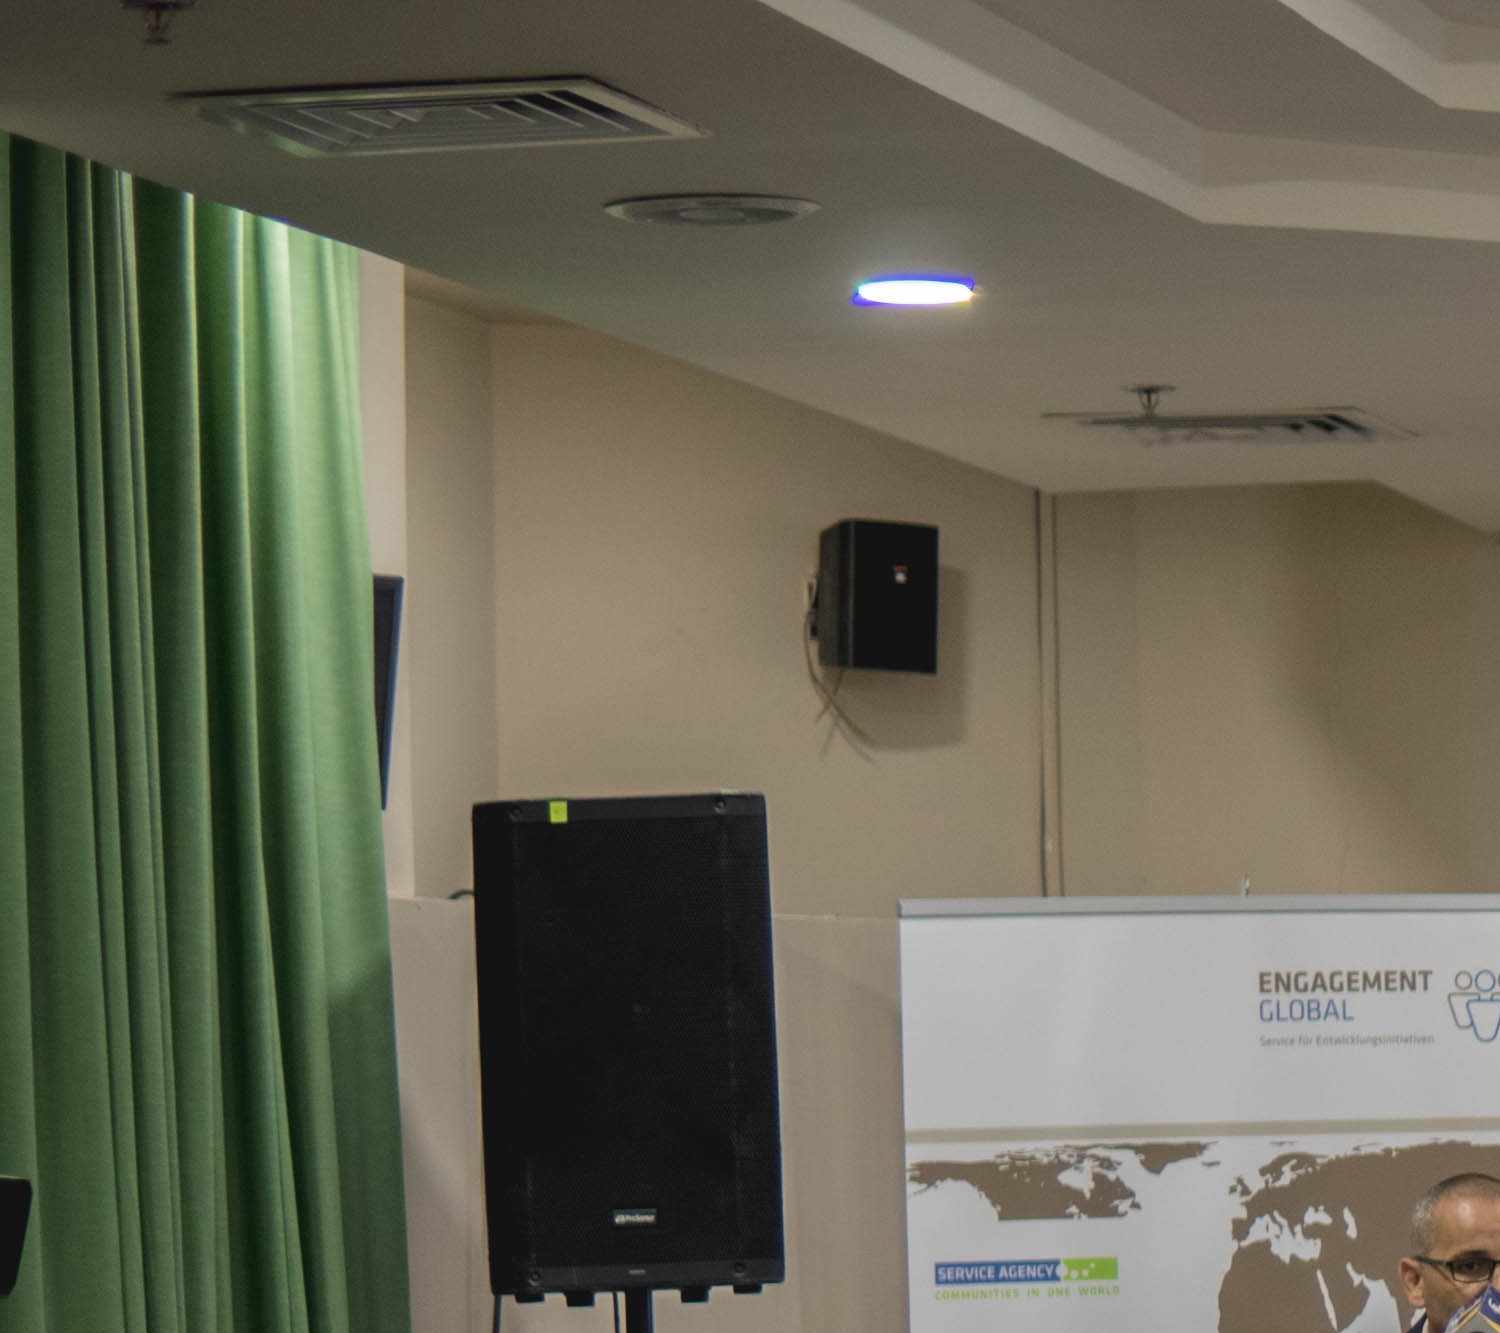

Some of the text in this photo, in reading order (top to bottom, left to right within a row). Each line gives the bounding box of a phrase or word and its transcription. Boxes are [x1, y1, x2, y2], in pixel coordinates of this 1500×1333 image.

[1258, 970, 1433, 994] ENGAGEMENT
[1259, 998, 1355, 1023] GLOBAL
[1259, 1035, 1296, 1047] Service
[937, 1264, 1054, 1281] SERVICE AGENCY
[935, 1284, 1120, 1301] COMMUNITIES IN ONE WORLD
